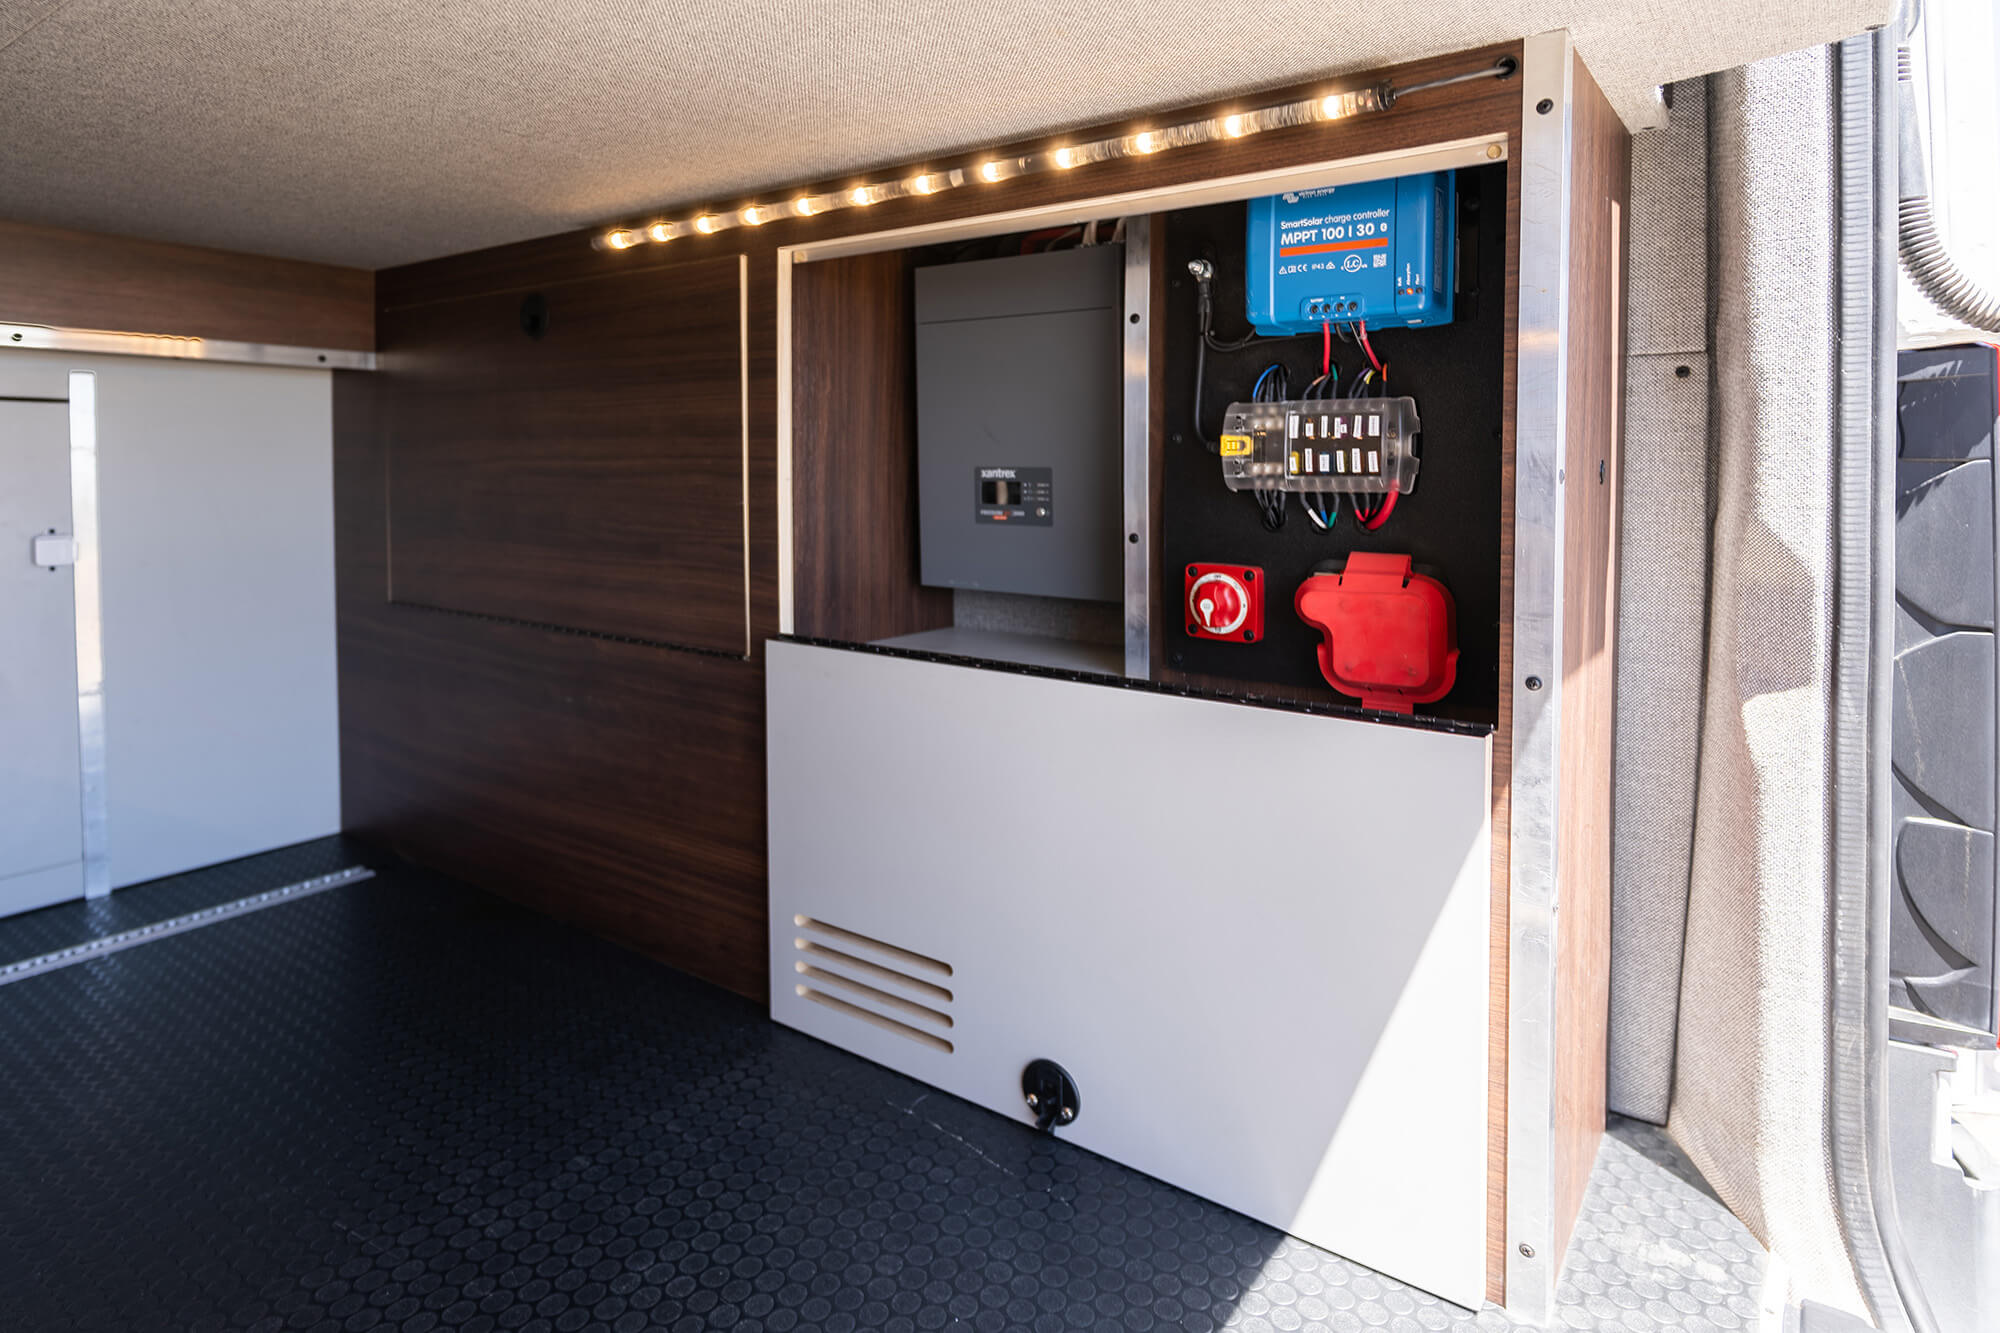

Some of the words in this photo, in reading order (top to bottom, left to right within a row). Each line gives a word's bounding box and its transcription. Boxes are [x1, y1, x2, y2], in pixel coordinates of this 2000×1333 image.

[1280, 217, 1322, 230] SmartSolar
[1324, 214, 1351, 224] charge
[1353, 208, 1390, 220] controller
[1280, 229, 1318, 245] MPPT
[1321, 226, 1345, 241] 100
[1356, 222, 1375, 236] 30
[980, 468, 1016, 478] xantrex
